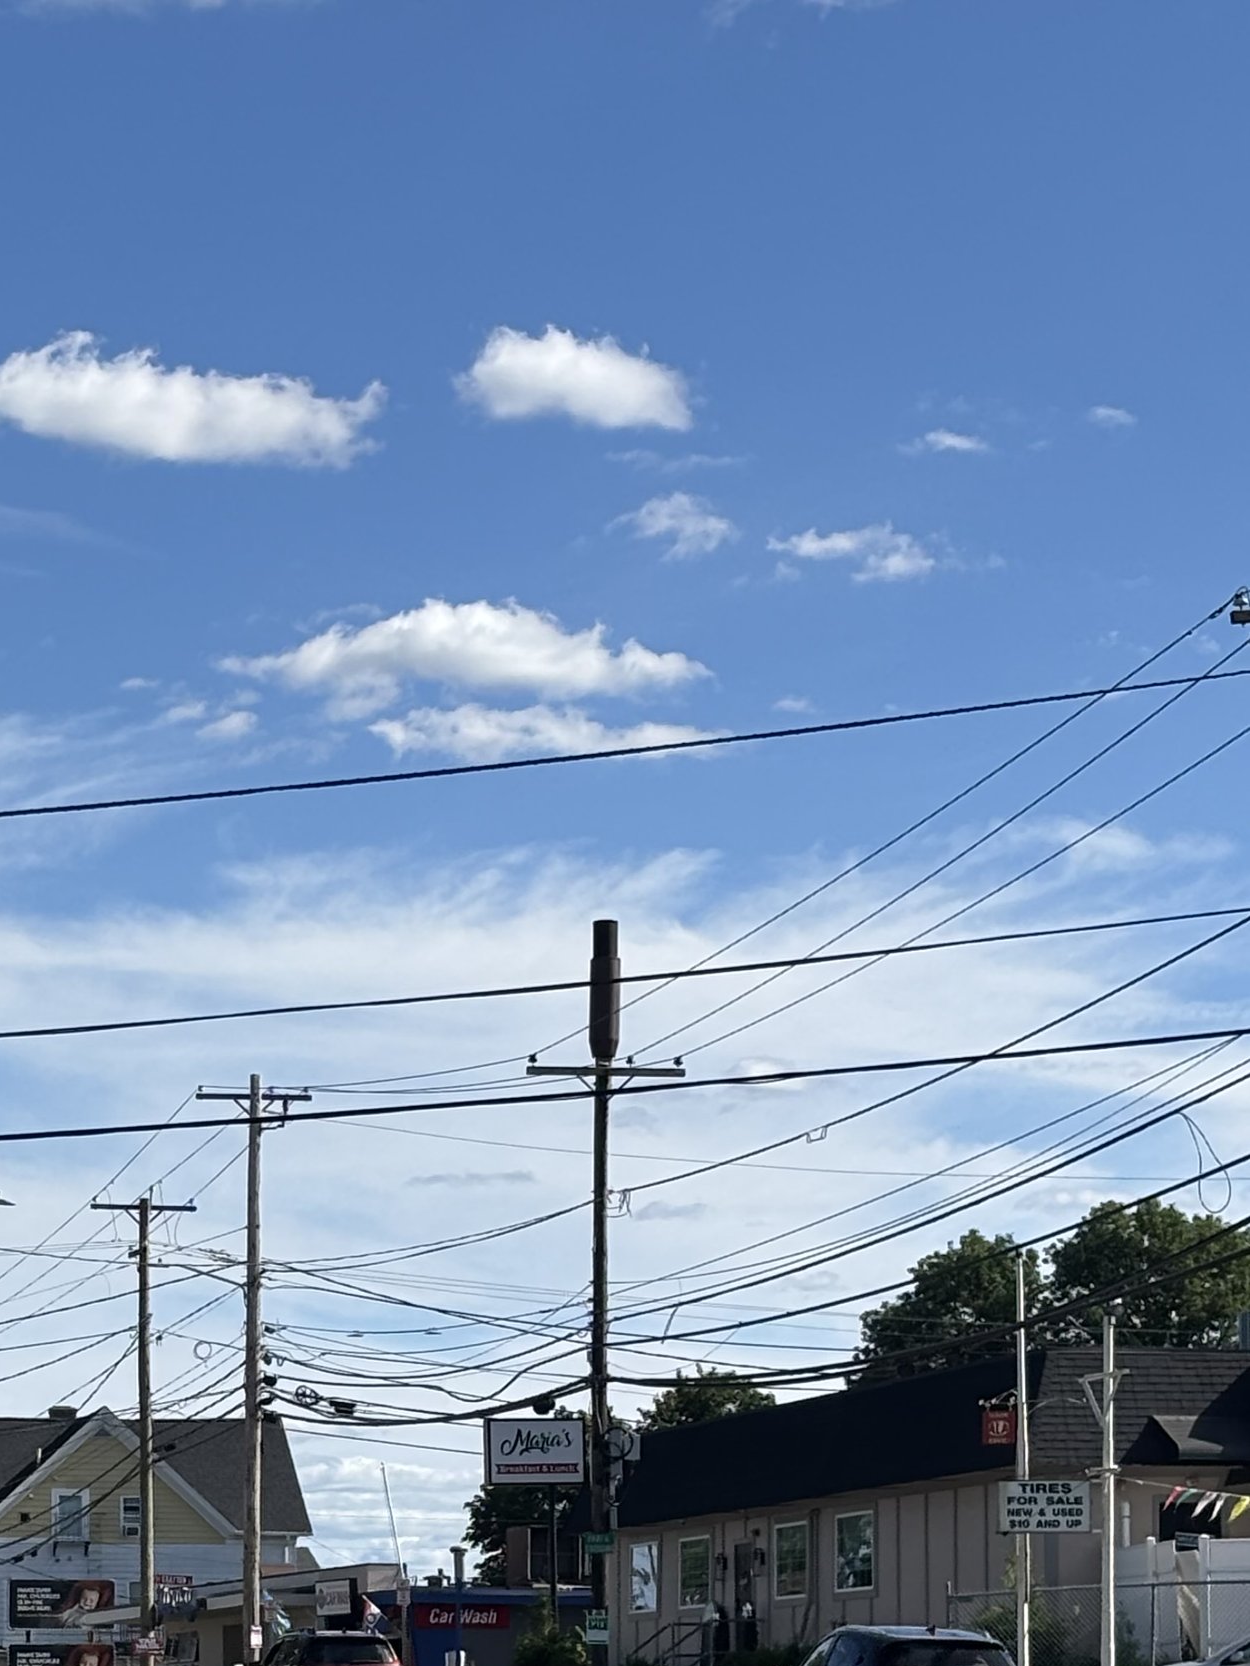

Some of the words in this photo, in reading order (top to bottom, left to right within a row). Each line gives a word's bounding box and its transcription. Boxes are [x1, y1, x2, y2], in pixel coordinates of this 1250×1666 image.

[500, 1428, 574, 1457] Maria's
[1018, 1483, 1072, 1495] TIRES
[1007, 1496, 1038, 1506] FOR
[1046, 1496, 1083, 1506] SALE
[1007, 1508, 1032, 1517] NEW
[1038, 1508, 1046, 1517] &
[1052, 1508, 1083, 1517] USED
[1009, 1519, 1030, 1529] $10
[1036, 1519, 1061, 1529] AND
[1066, 1519, 1082, 1529] UP
[430, 1608, 455, 1624] Car
[460, 1608, 497, 1624] Wash
